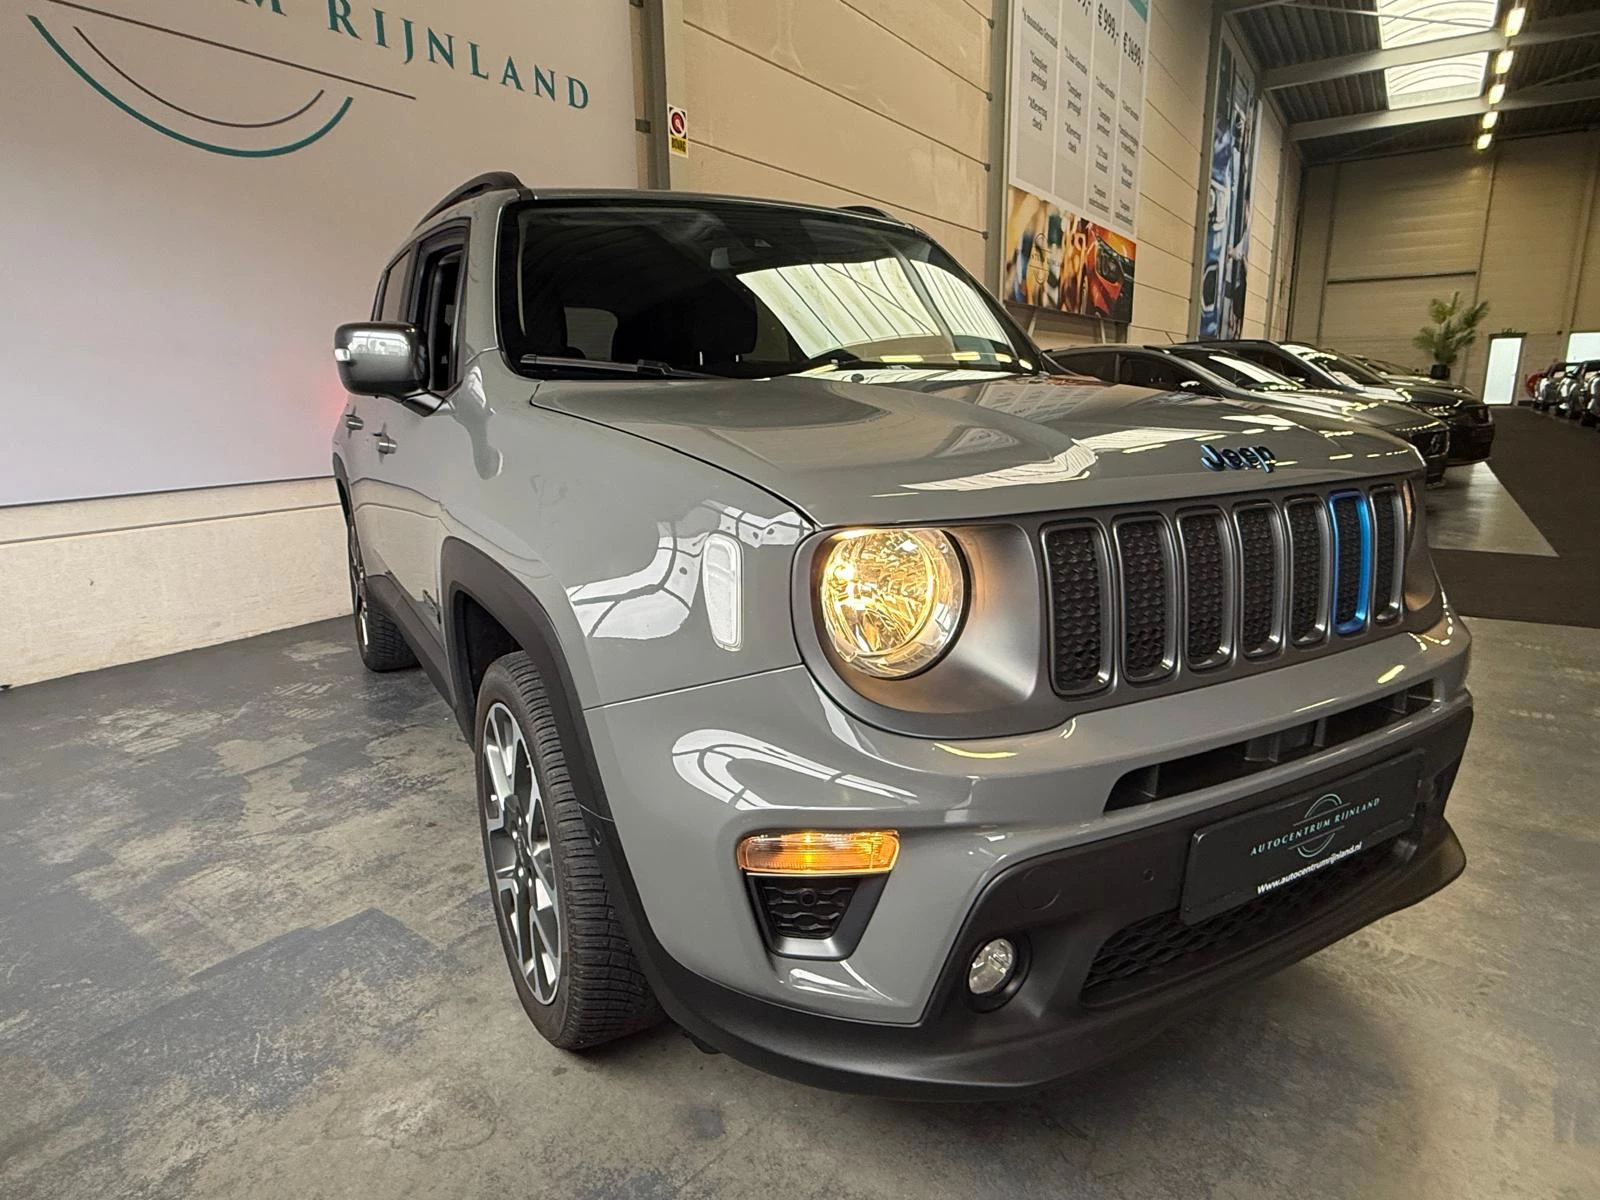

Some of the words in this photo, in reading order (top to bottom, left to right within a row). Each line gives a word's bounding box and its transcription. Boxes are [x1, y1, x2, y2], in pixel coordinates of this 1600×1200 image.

[327, 0, 590, 110] RIJNLAND
[1199, 444, 1276, 473] Jeep
[1250, 818, 1331, 856] AUTOCENTRUM
[1334, 797, 1381, 823] RIJNLAND
